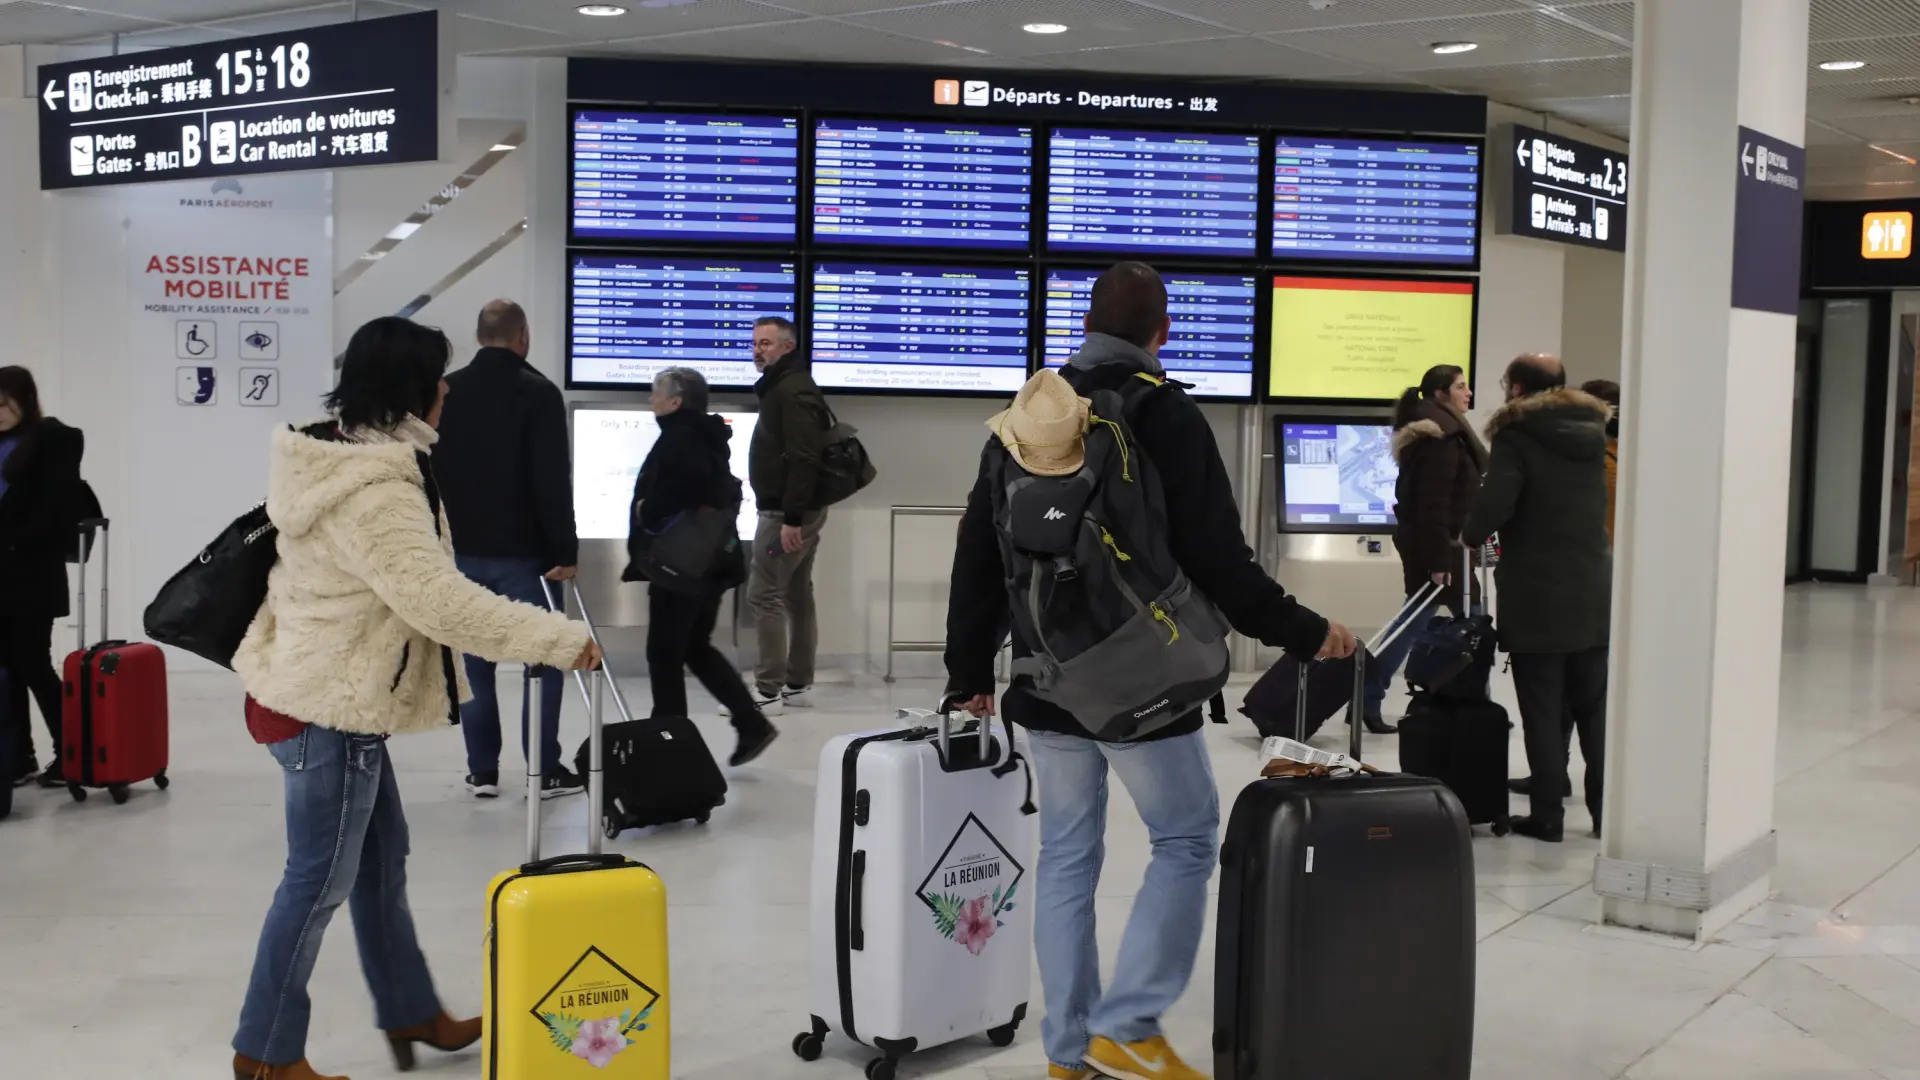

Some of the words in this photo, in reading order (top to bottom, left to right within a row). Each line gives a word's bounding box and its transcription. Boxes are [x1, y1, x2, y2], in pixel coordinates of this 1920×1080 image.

[94, 58, 193, 88] Enregistrement
[216, 49, 252, 96] 15
[271, 41, 310, 89] 18
[256, 65, 267, 77] to
[95, 85, 149, 110] Check-in
[993, 88, 1060, 105] Départs
[1078, 91, 1173, 110] Departures
[1190, 97, 1218, 112] 出发
[240, 113, 302, 139] Location
[306, 113, 325, 132] de
[330, 107, 396, 130] voitures
[96, 133, 136, 152] Portes
[182, 125, 201, 168] B
[240, 143, 264, 163] Car
[268, 138, 316, 161] Rental
[1547, 142, 1575, 164] Départs
[97, 155, 132, 175] Gates
[1547, 162, 1585, 184] Departures
[1603, 158, 1626, 196] 2,3
[1547, 197, 1576, 217] Arrivées
[1546, 216, 1574, 235] Arrivals
[145, 255, 309, 277] ASSISTANCE
[164, 277, 290, 300] MOBILITÉ
[145, 304, 193, 313] MOBILITY
[197, 305, 260, 315] ASSISTANCE
[601, 420, 621, 430] Orly
[1133, 698, 1169, 719] Quechua
[944, 871, 957, 888] LA
[960, 861, 1000, 885] RÉUNION
[561, 994, 574, 1009] LA
[578, 987, 629, 1007] RÉUNION
